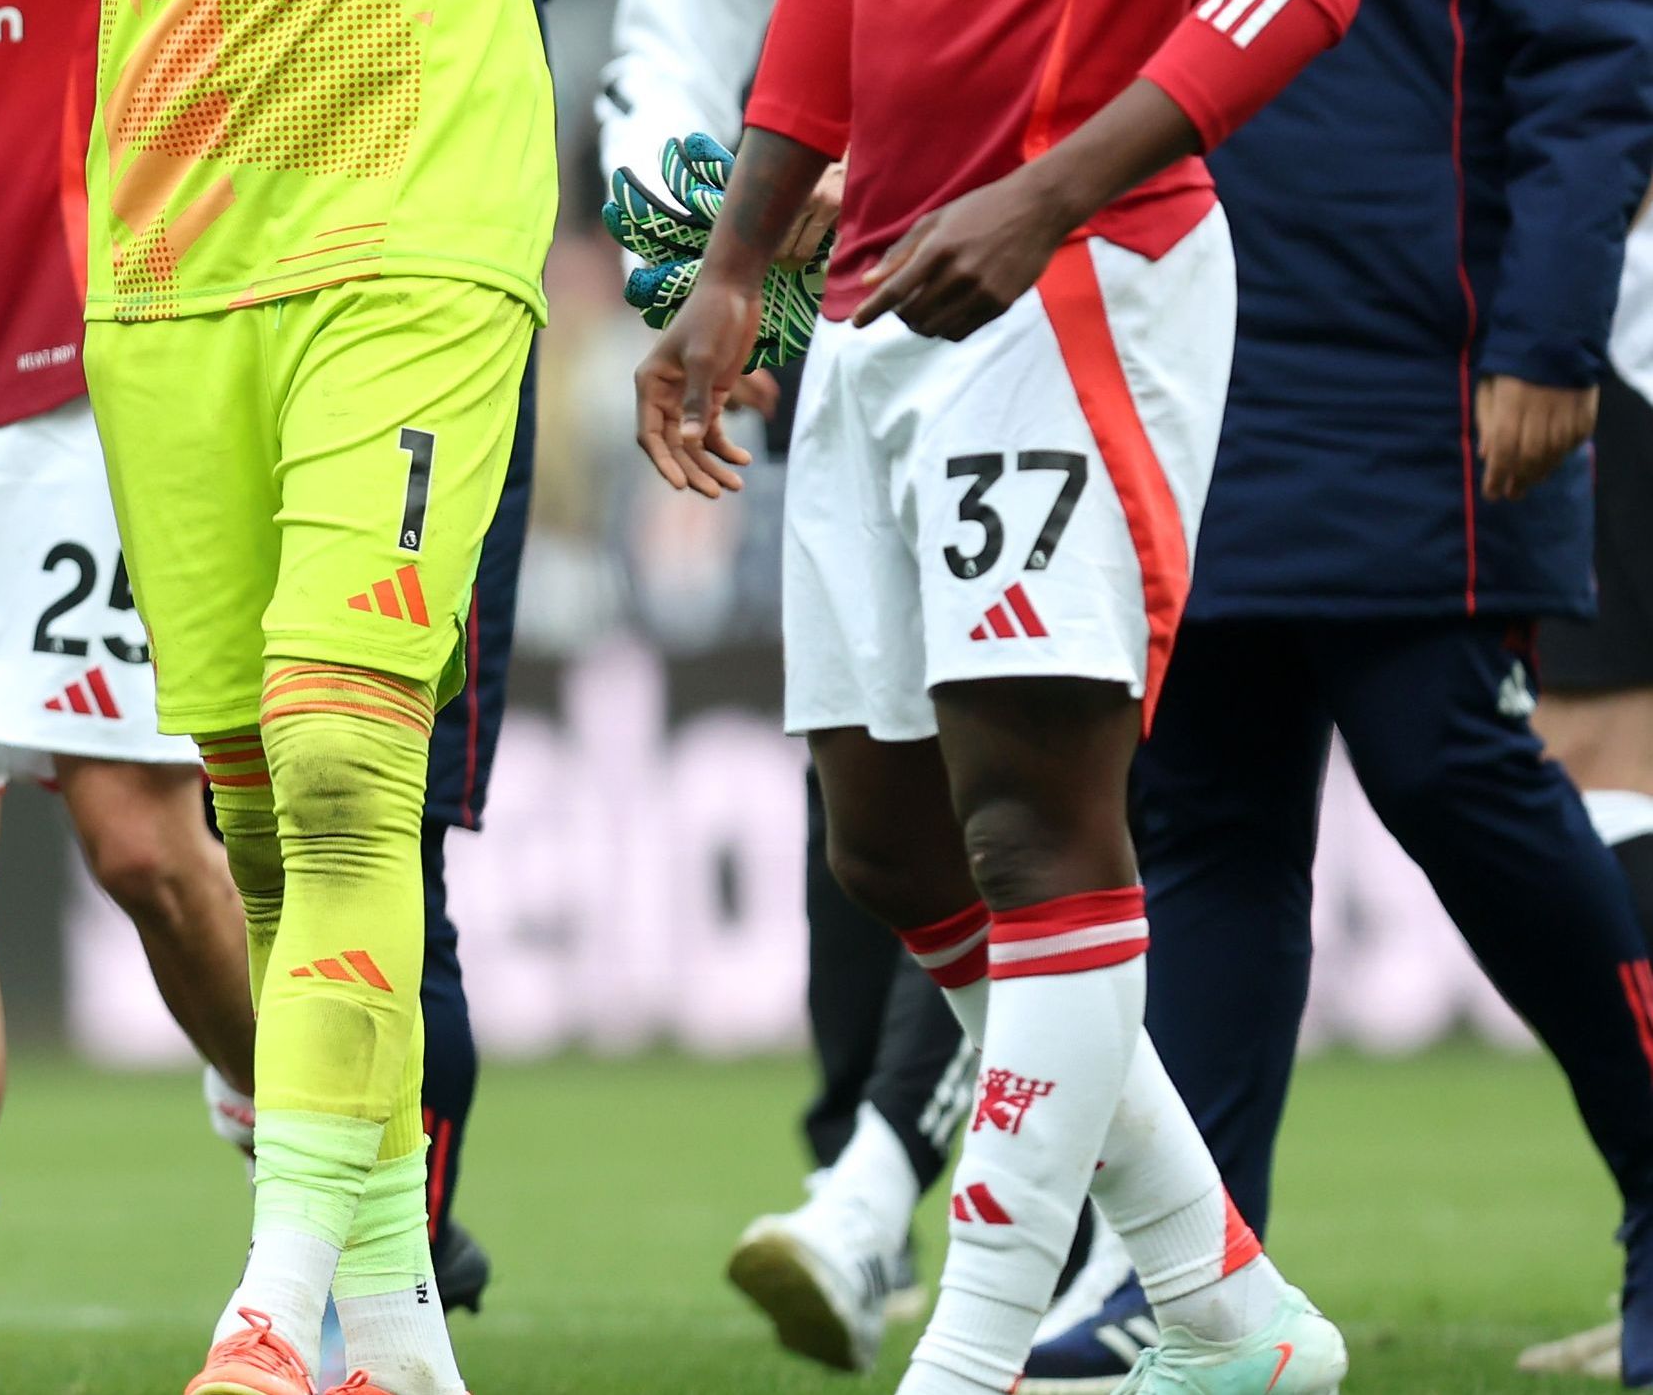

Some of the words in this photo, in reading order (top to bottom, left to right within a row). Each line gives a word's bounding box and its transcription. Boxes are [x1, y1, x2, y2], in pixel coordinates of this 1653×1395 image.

[397, 426, 435, 552] 1
[943, 449, 1089, 580] 37
[32, 540, 153, 664] 25
